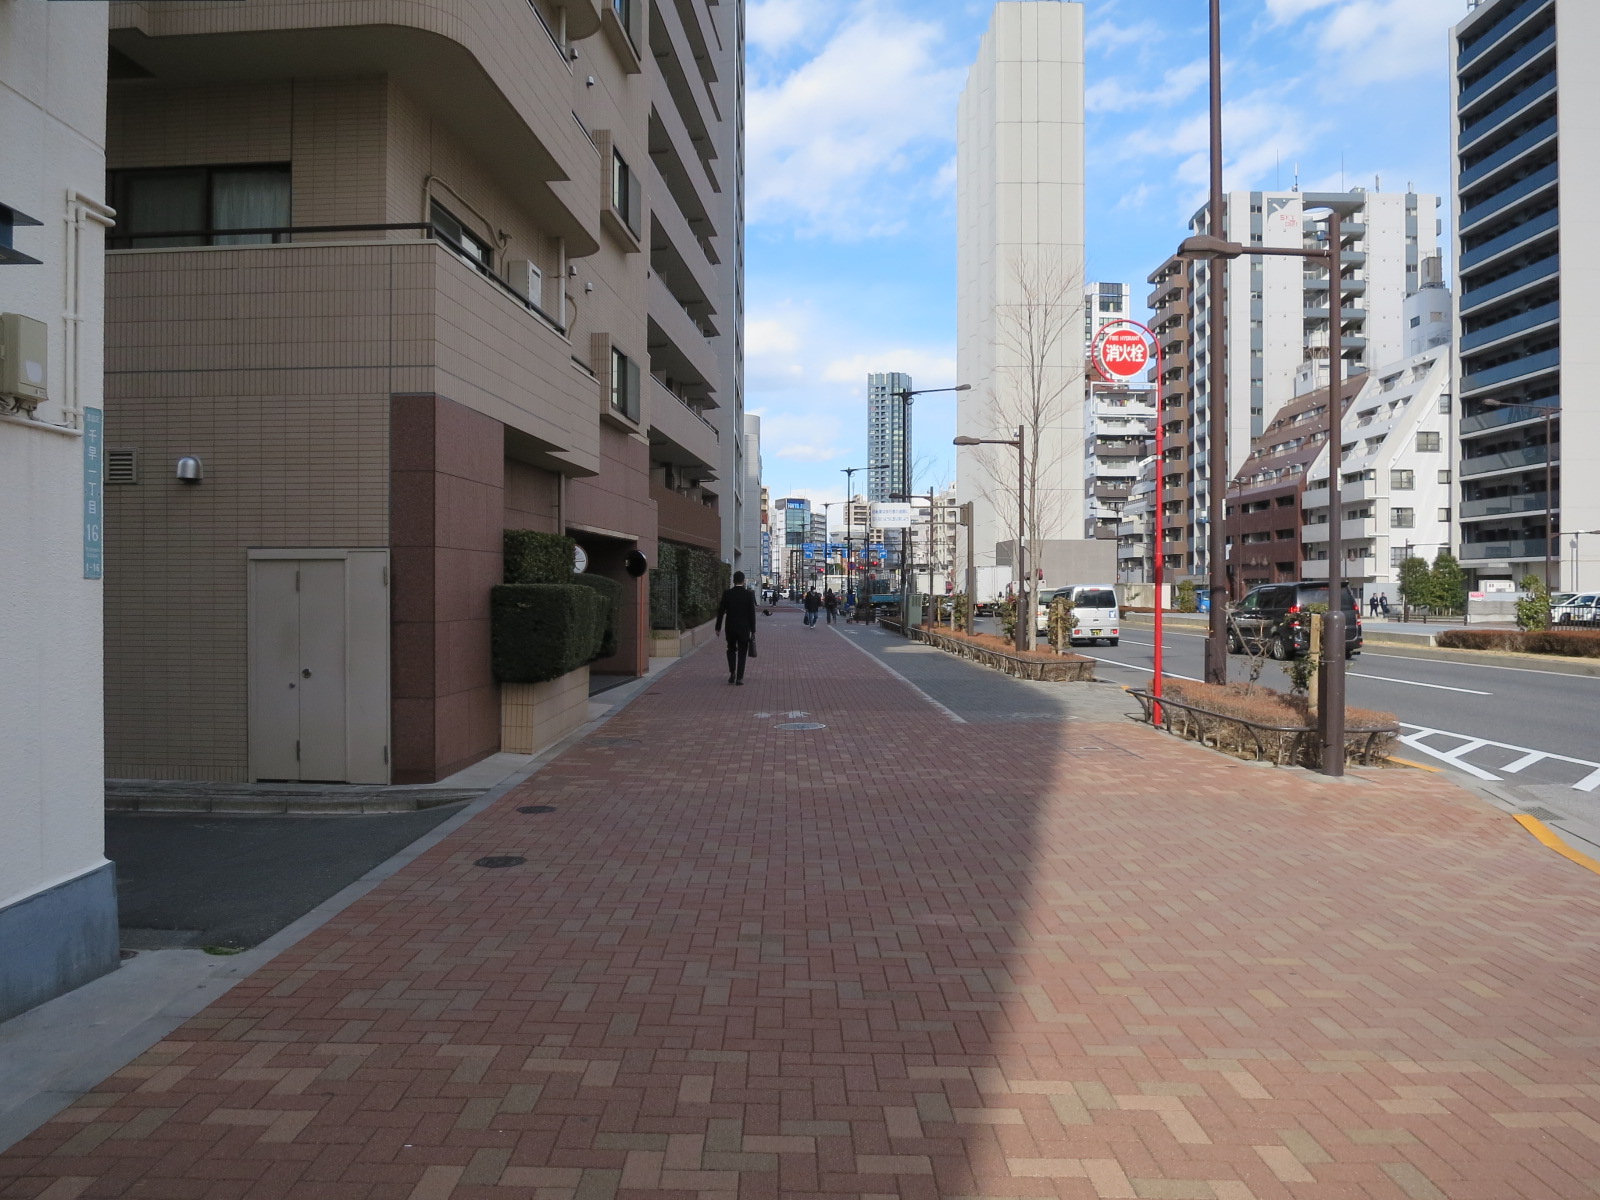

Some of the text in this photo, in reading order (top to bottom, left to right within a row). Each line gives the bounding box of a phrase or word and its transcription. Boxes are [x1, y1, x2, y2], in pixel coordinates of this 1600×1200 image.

[1106, 344, 1144, 362] 消火栓
[88, 429, 97, 515] 千早一丁目
[86, 524, 99, 542] 16
[86, 563, 100, 573] 1-16
